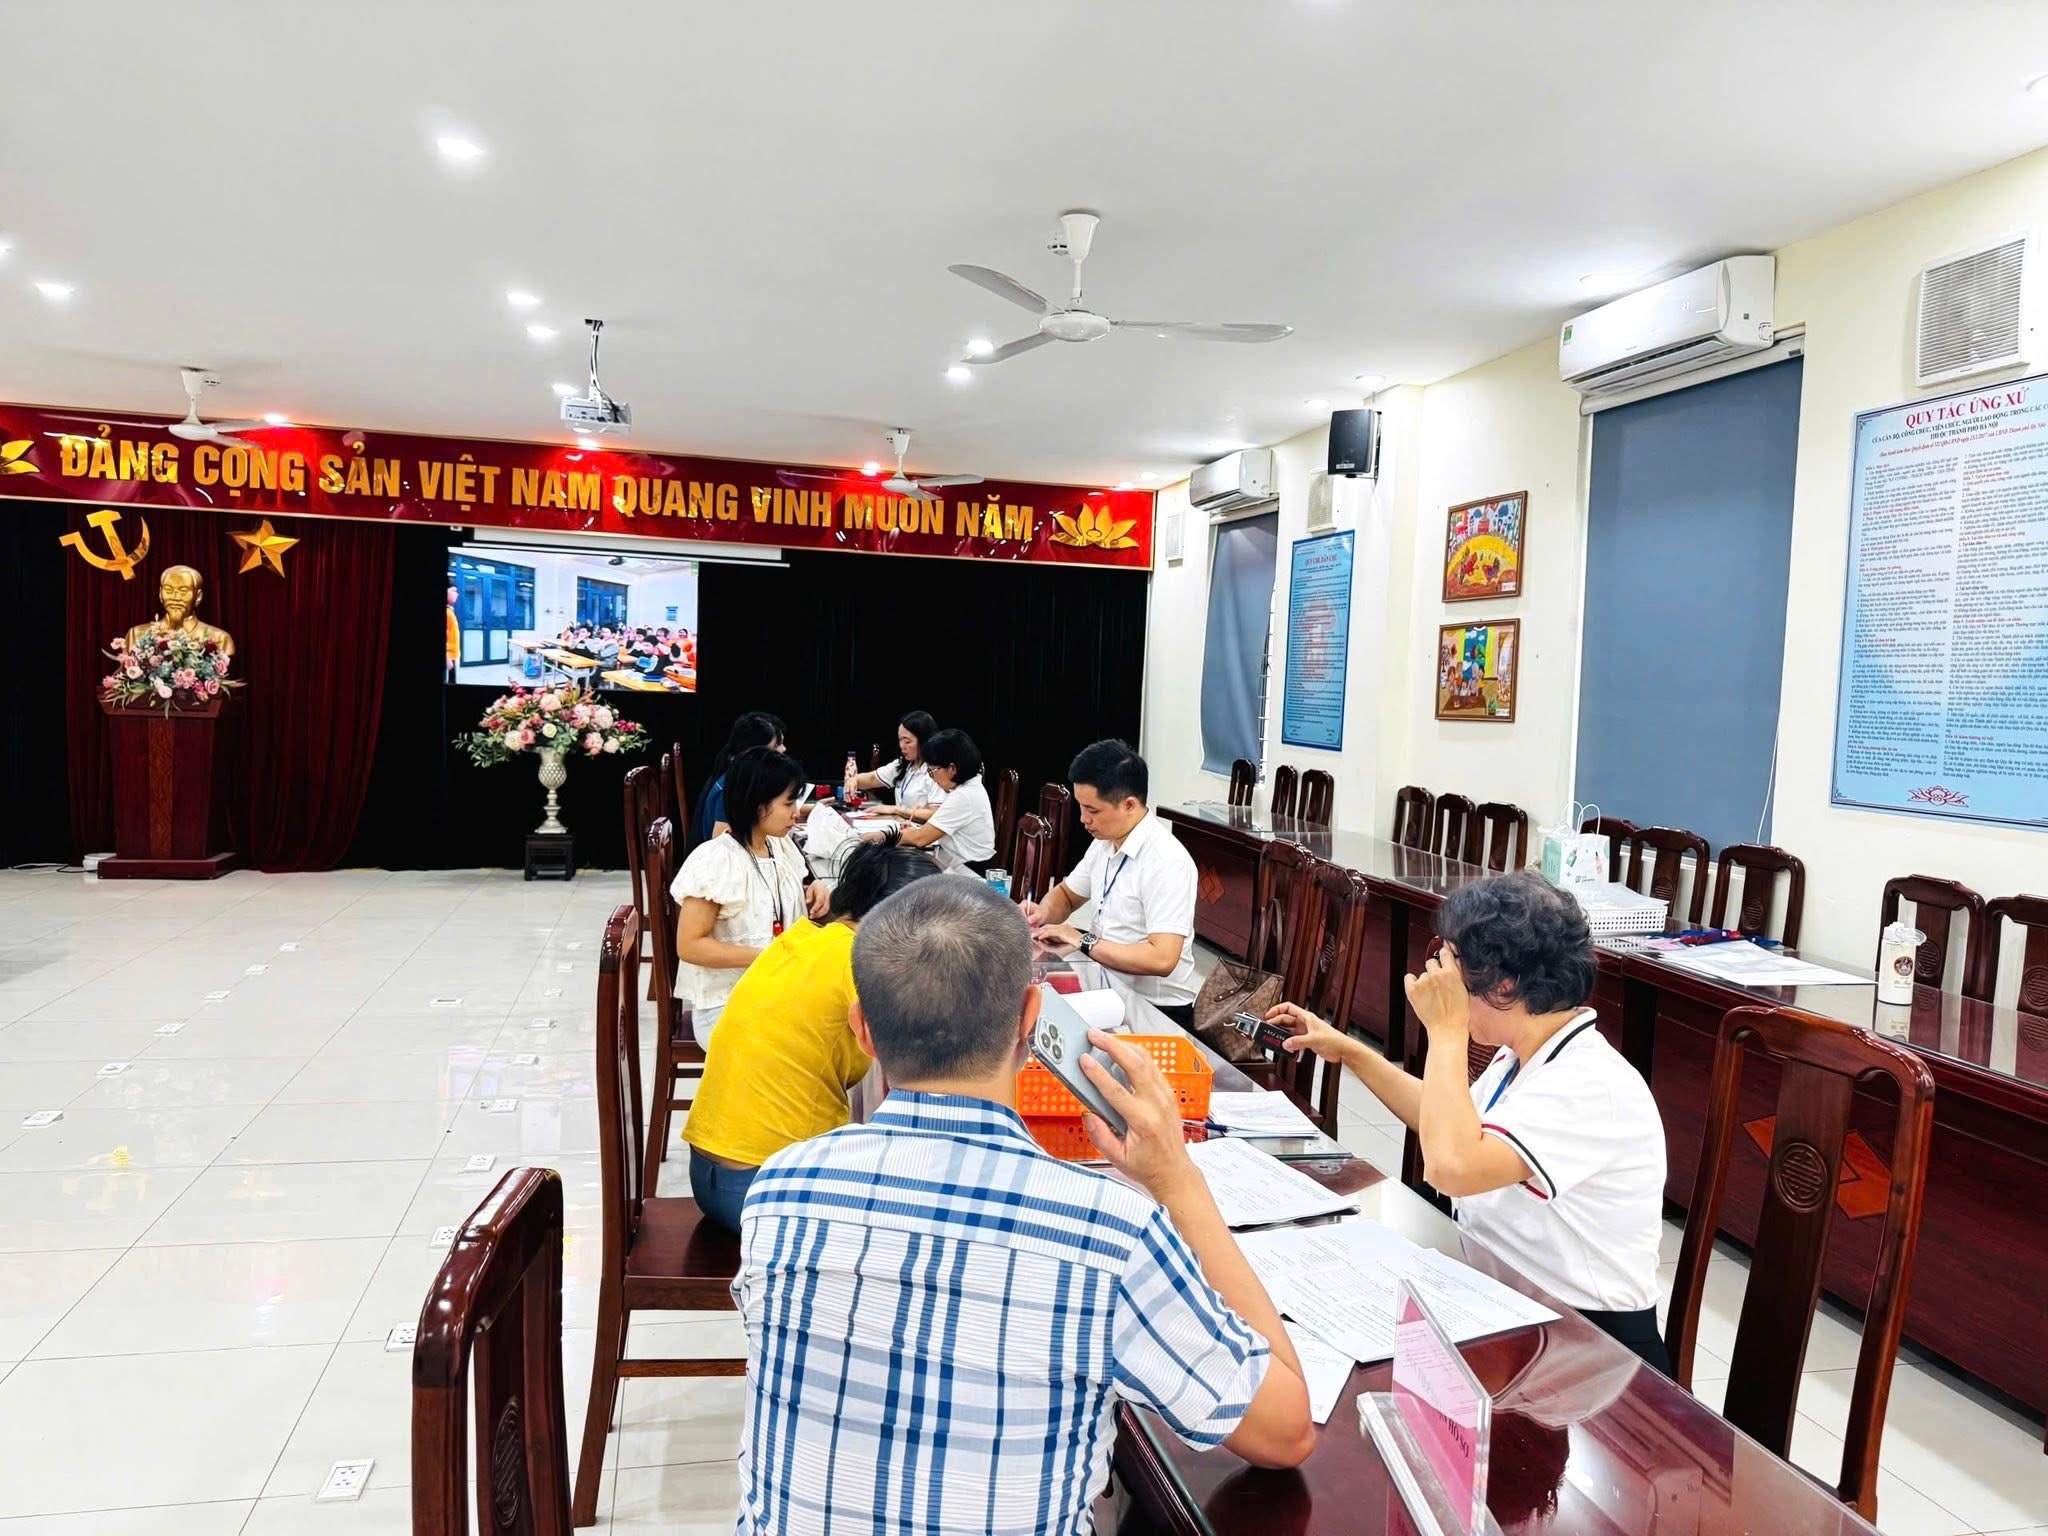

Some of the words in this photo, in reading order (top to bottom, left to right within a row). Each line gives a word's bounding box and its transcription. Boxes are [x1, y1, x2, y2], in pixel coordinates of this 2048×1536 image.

[1906, 409, 1934, 428] QUY
[58, 423, 179, 483] ĐẢNG
[318, 441, 401, 494] SẢN
[418, 454, 501, 511] VIỆT
[511, 468, 601, 511] NAM
[613, 475, 739, 521] QUANG
[750, 486, 832, 527] VINH
[956, 494, 1033, 541] NĂM
